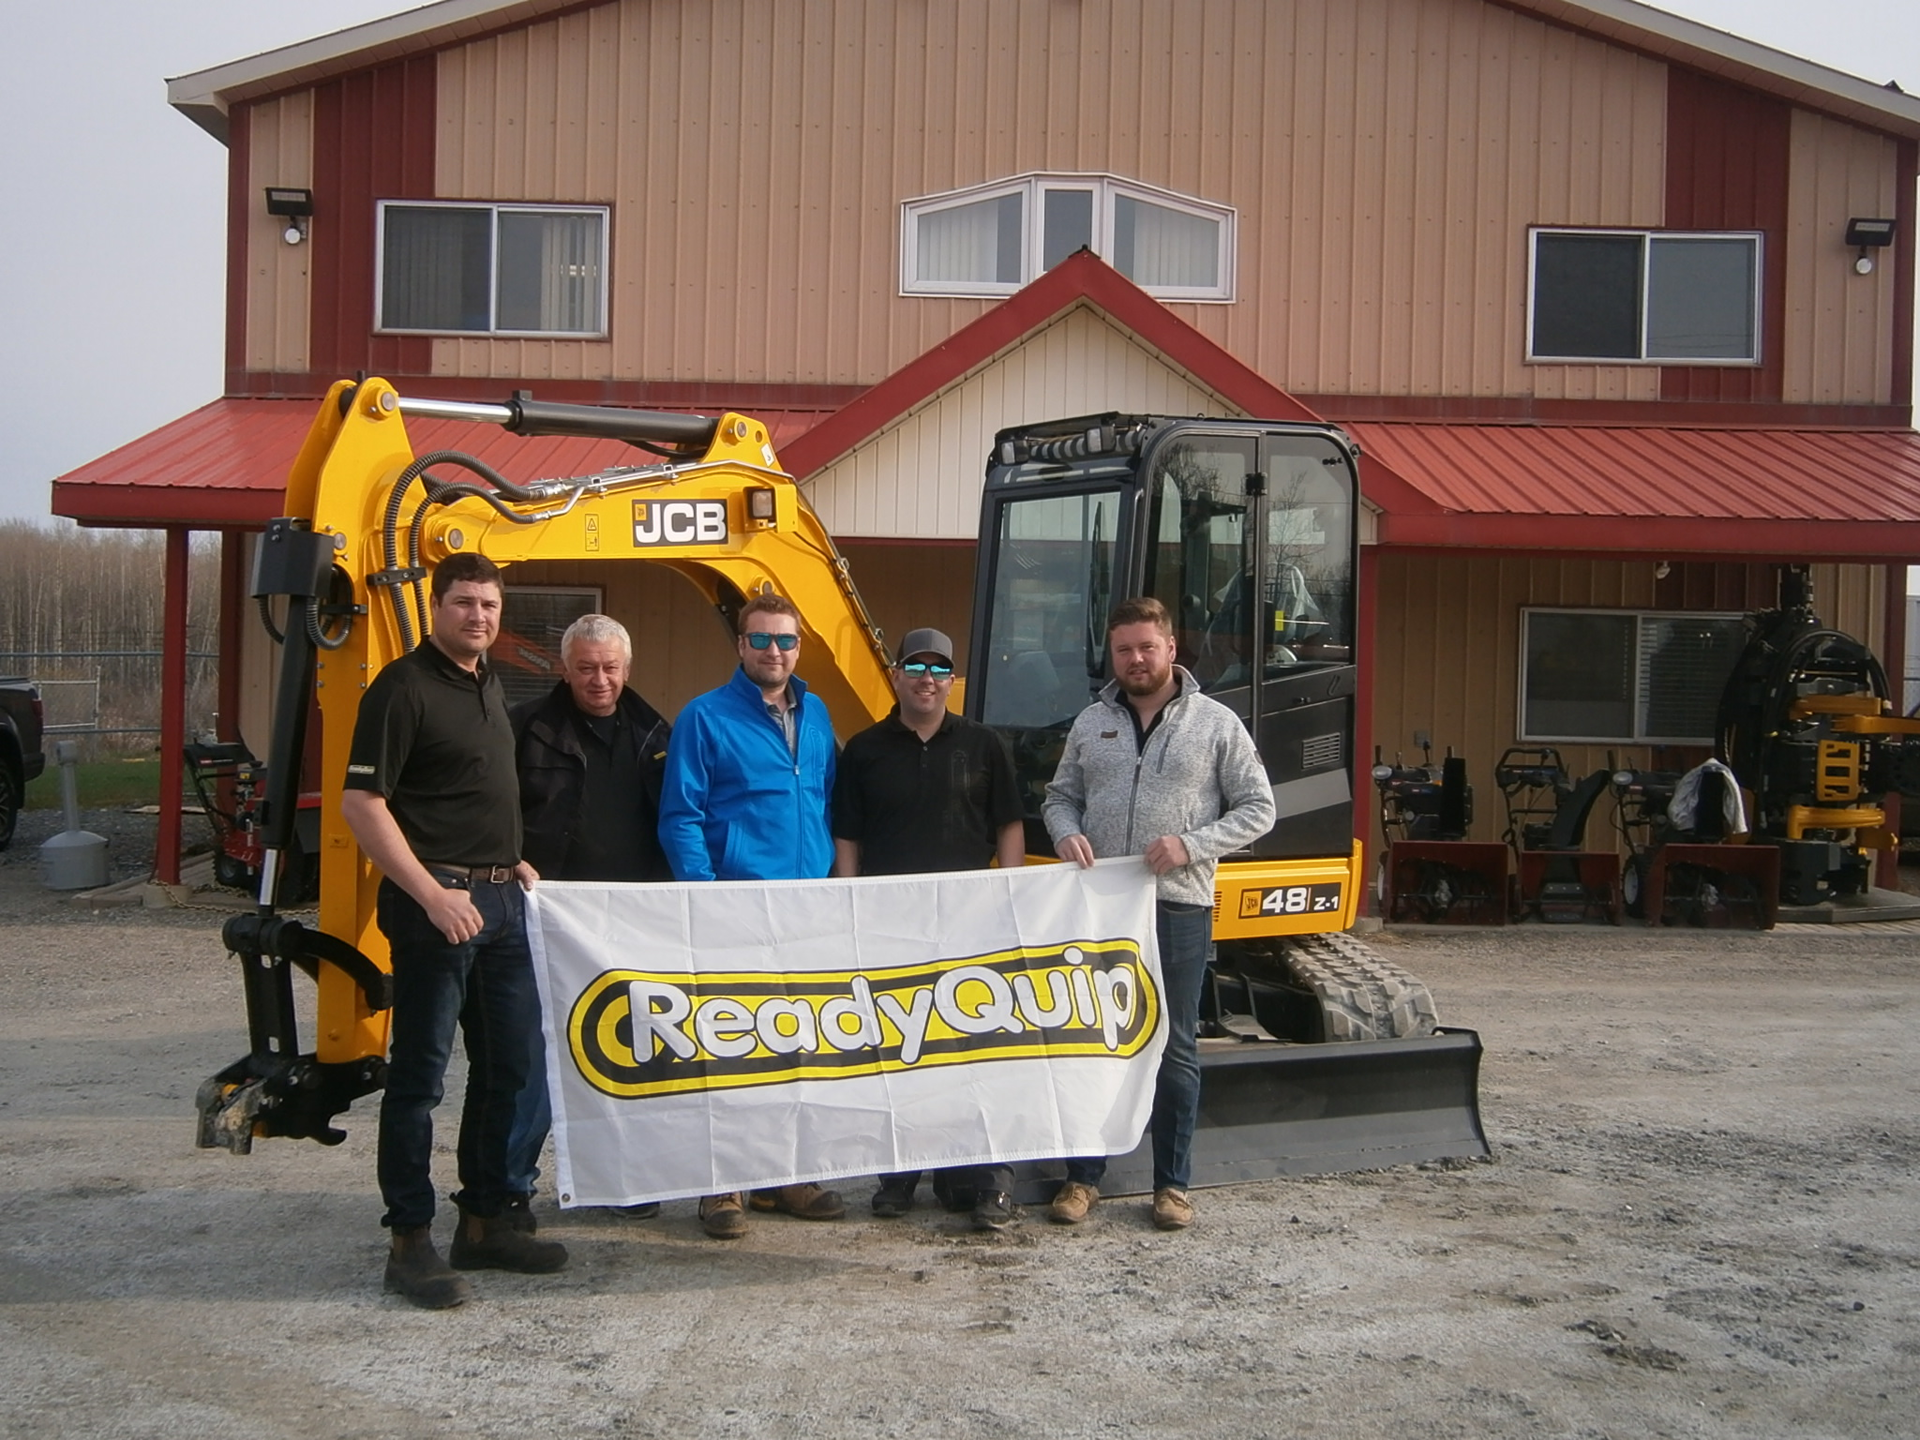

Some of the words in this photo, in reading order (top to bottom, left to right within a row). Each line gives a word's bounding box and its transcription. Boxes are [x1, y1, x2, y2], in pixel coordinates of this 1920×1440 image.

[635, 503, 727, 544] JCB
[1262, 887, 1307, 913] 48
[627, 946, 1136, 1063] ReadyQuip
